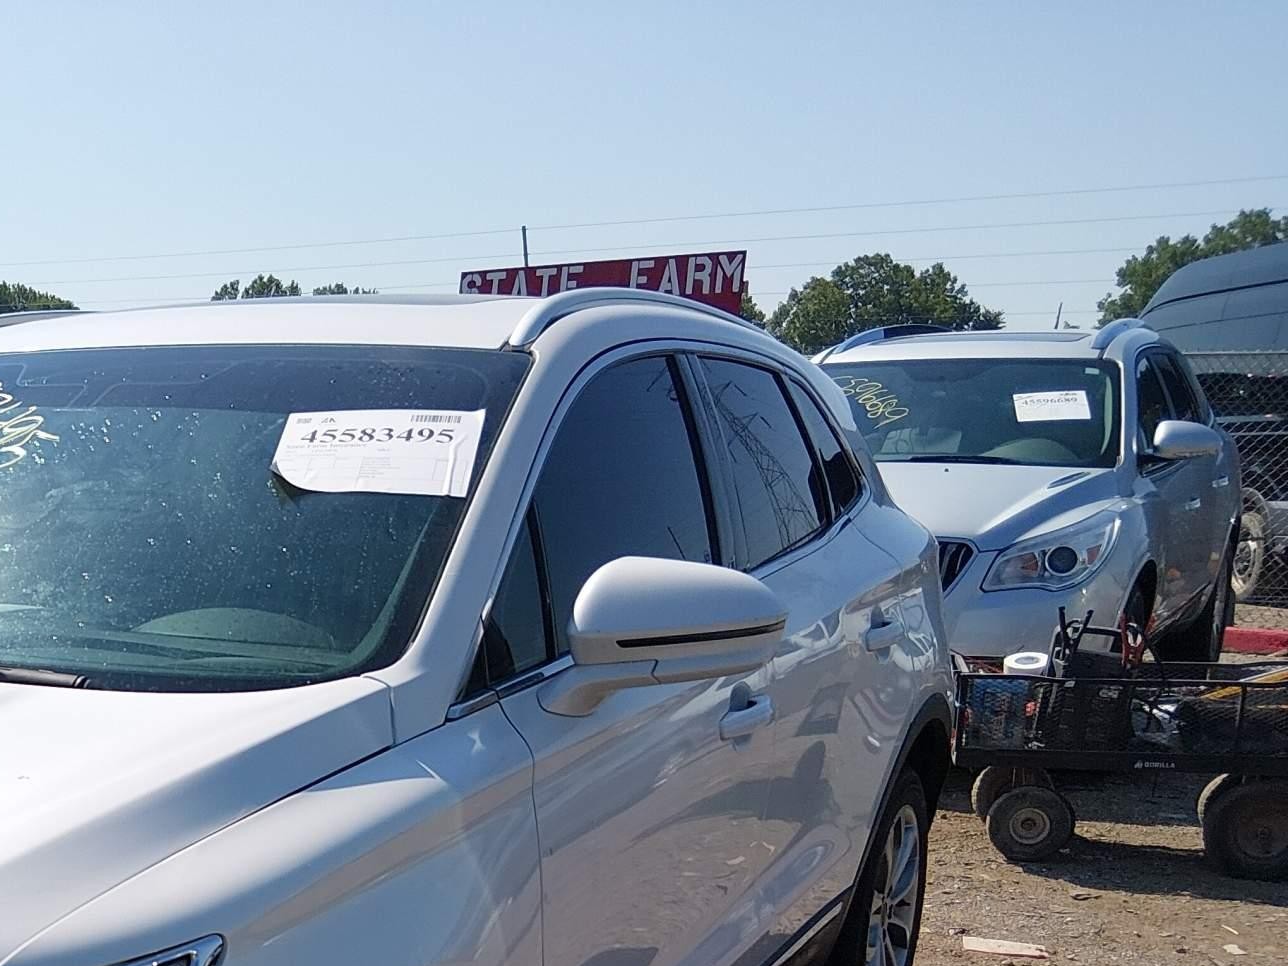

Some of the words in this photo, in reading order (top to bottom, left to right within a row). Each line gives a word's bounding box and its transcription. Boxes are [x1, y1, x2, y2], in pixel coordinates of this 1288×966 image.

[630, 254, 744, 295] FARM
[300, 427, 455, 444] 45583495
[1144, 761, 1176, 769] GORILLA
